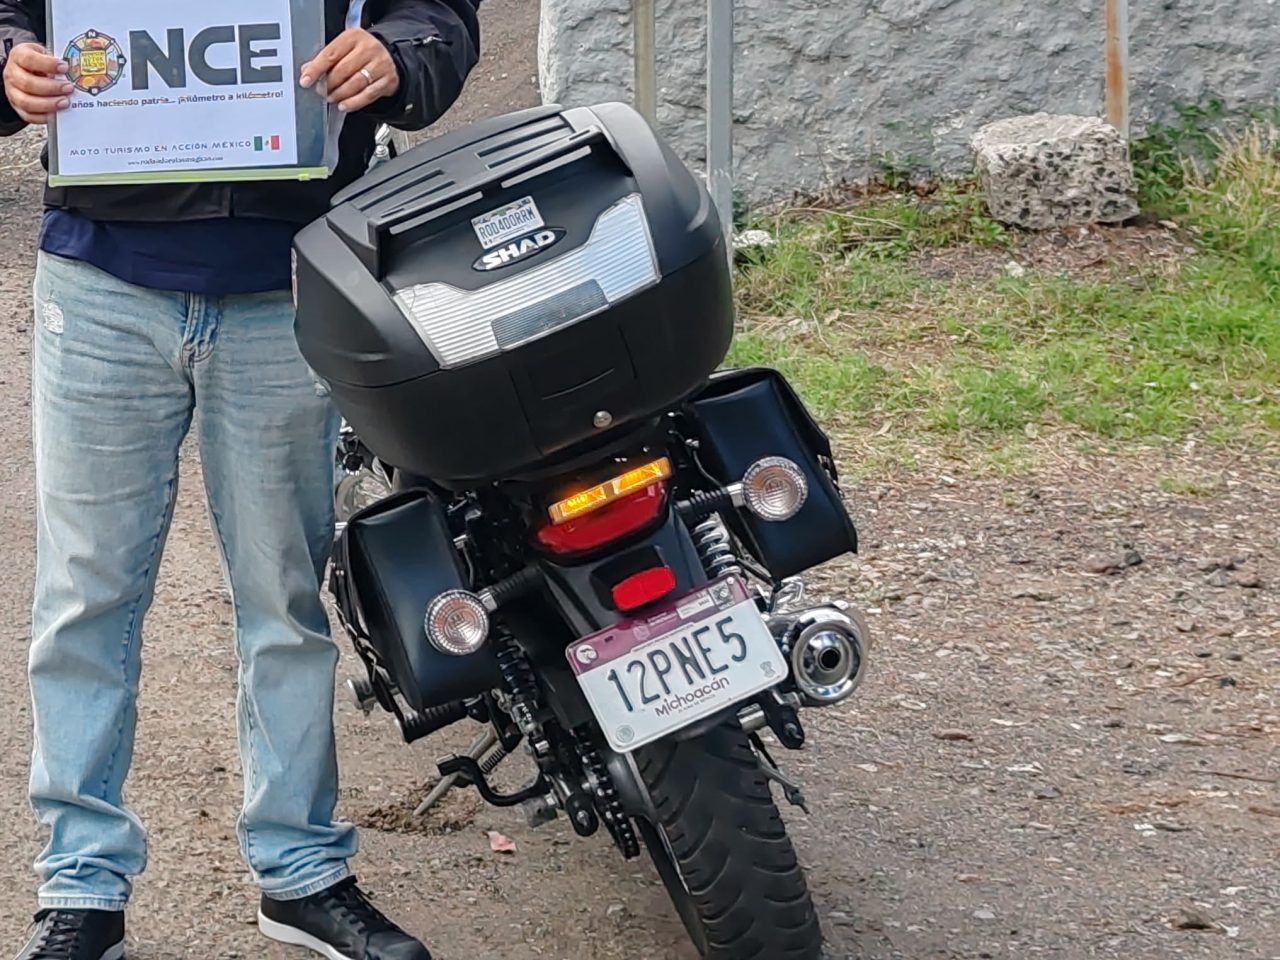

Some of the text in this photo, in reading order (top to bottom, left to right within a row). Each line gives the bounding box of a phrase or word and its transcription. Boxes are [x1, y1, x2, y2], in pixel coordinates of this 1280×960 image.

[69, 148, 100, 157] MOTO
[104, 145, 150, 155] TURISMO
[154, 145, 168, 153] EN
[482, 230, 556, 271] SHAD
[608, 616, 748, 713] 12PNE5
[654, 676, 731, 717] Michoacán
